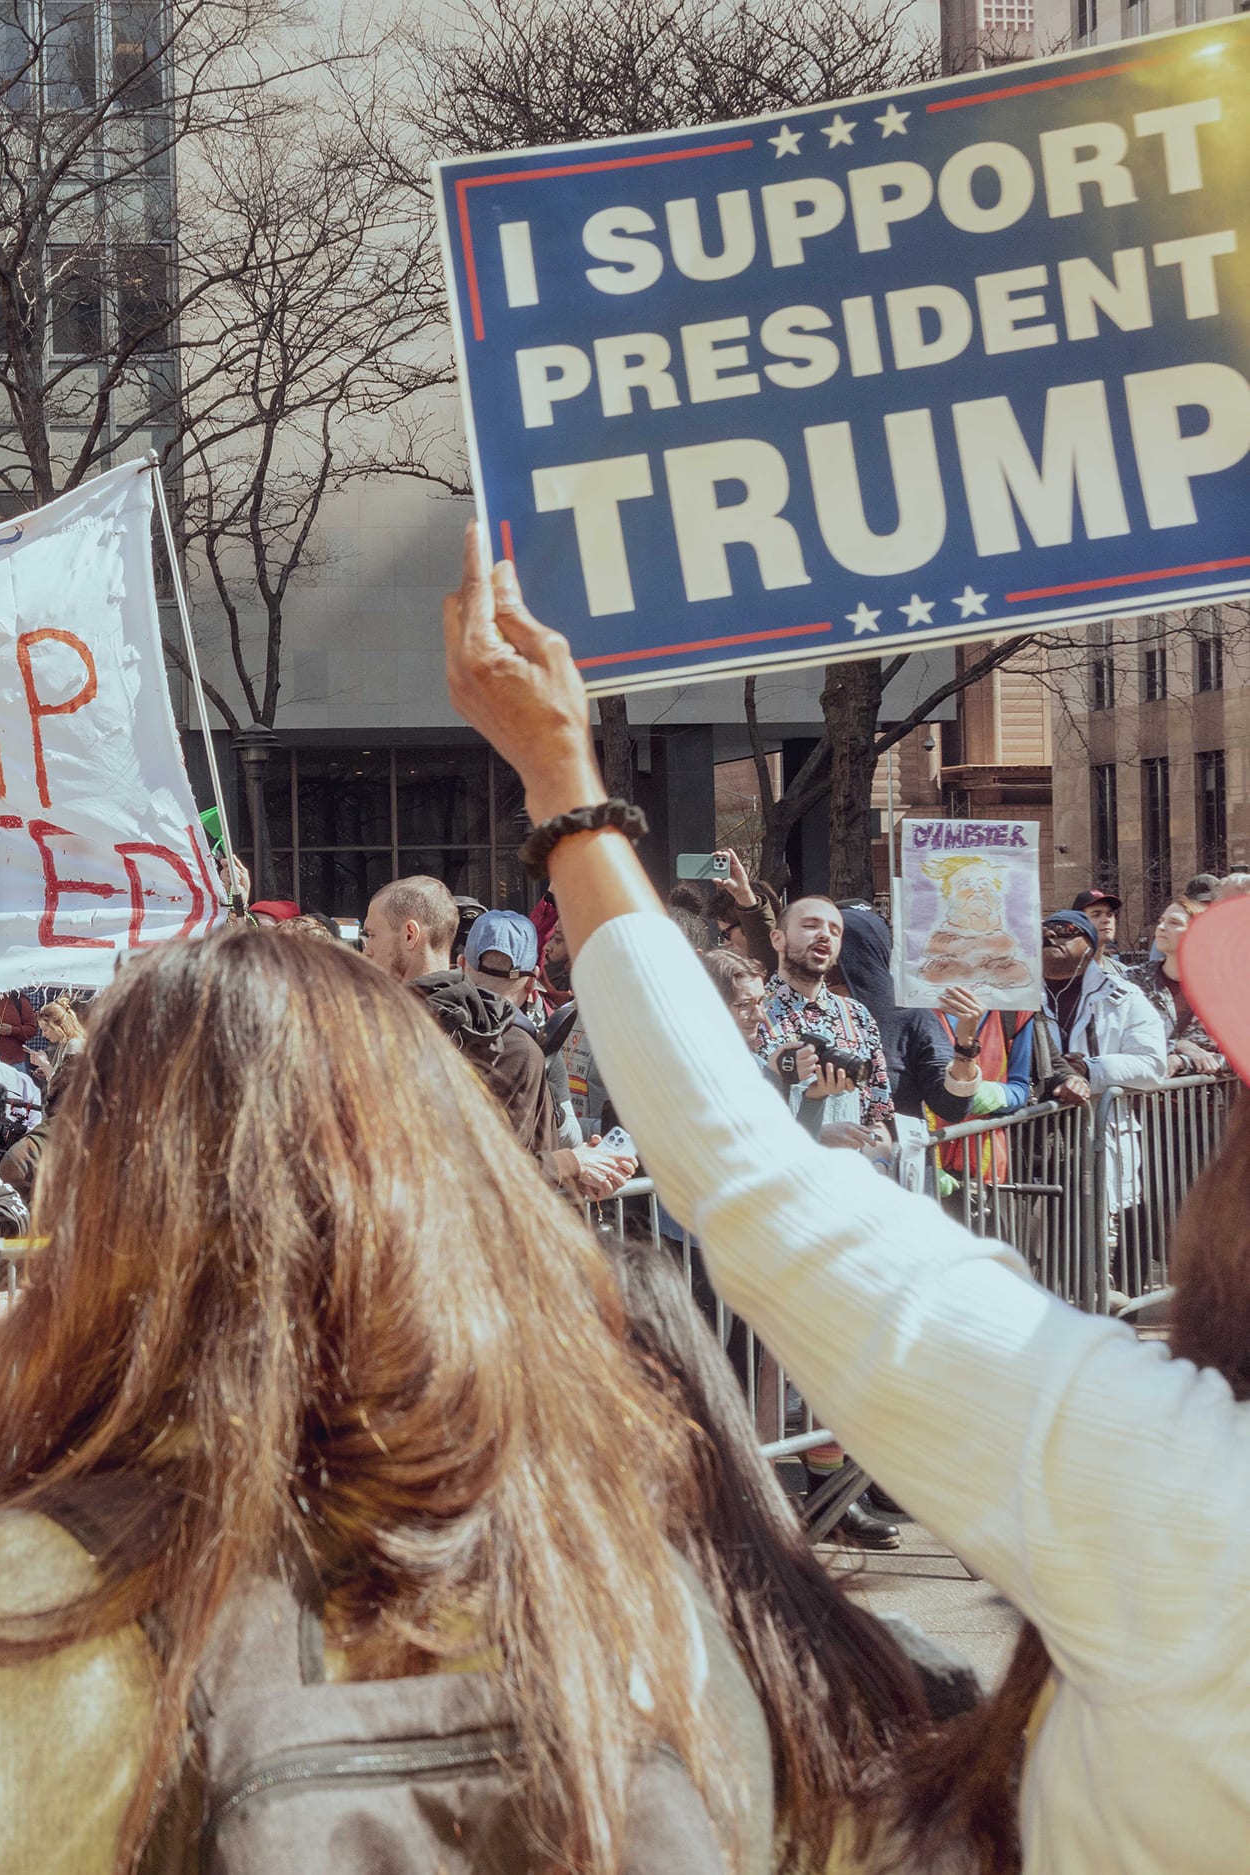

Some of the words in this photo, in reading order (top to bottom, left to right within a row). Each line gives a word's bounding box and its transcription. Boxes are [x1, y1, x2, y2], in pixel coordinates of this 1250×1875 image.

[498, 220, 539, 308] I
[581, 97, 1223, 296] SUPPORT
[515, 230, 1238, 430] PRESIDENT
[531, 362, 1250, 618] TRUMP
